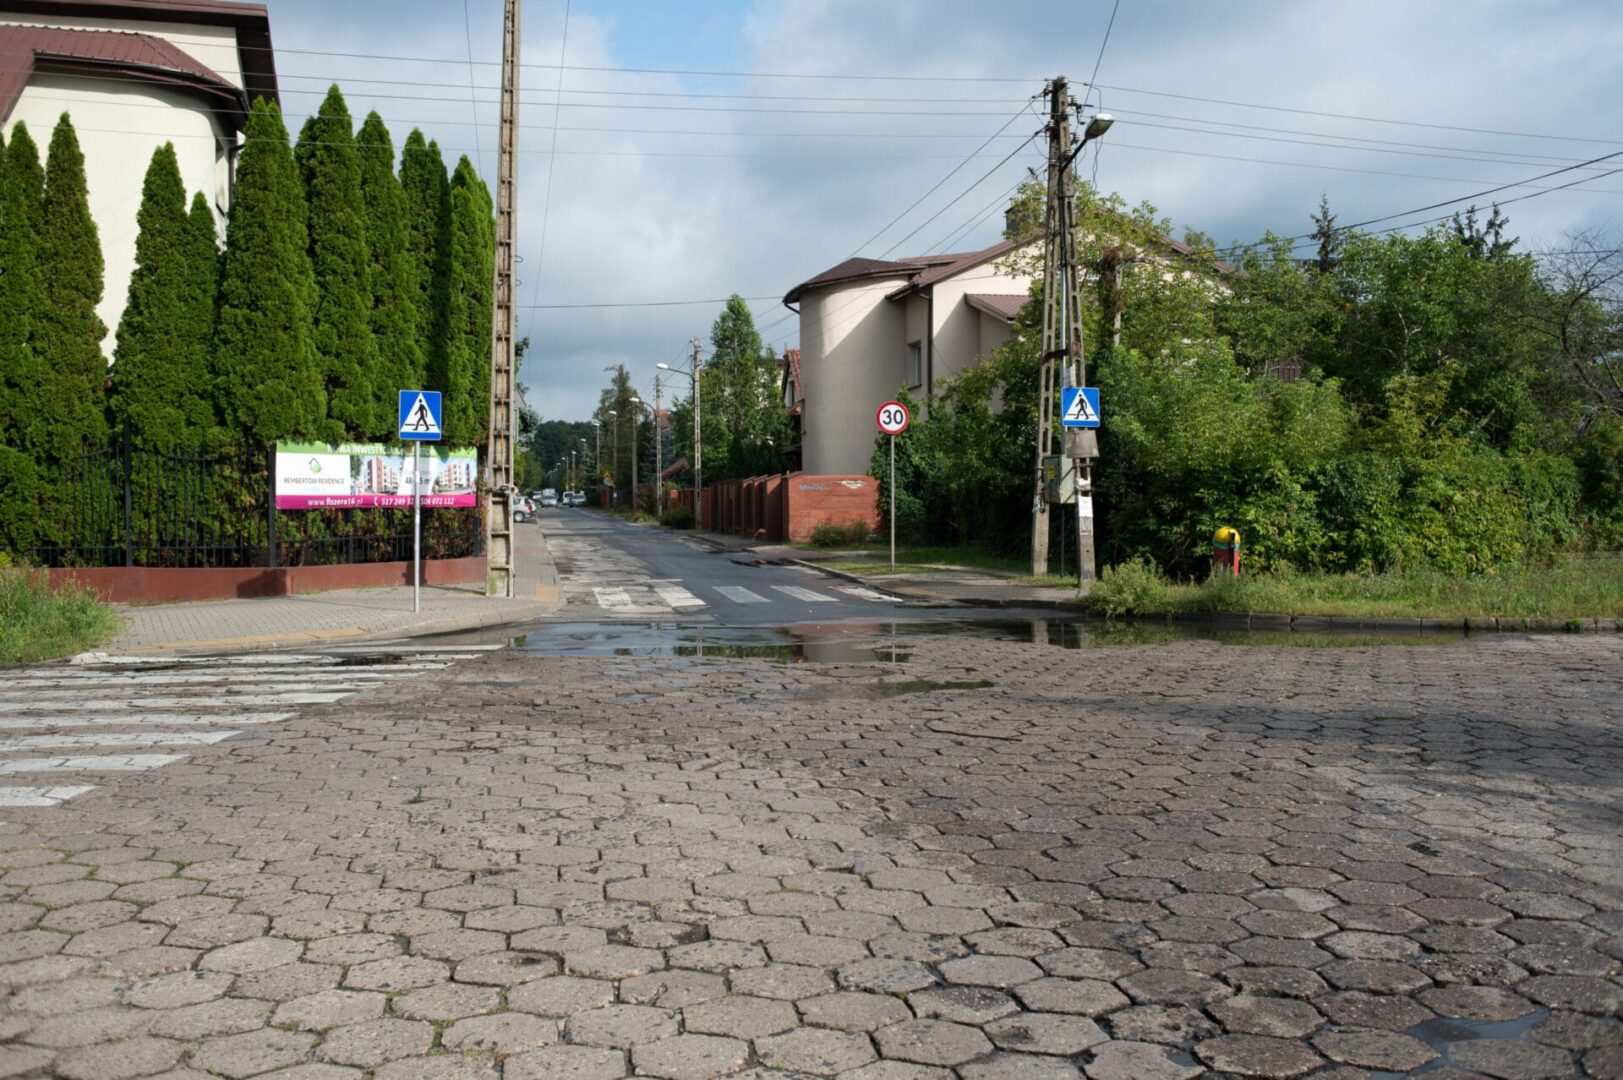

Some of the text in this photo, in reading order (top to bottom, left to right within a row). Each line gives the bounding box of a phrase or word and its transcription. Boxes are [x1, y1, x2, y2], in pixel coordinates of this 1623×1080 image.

[883, 409, 903, 425] 30
[318, 477, 345, 485] RESIDENCE
[381, 497, 393, 506] 517
[444, 497, 455, 505] 112
